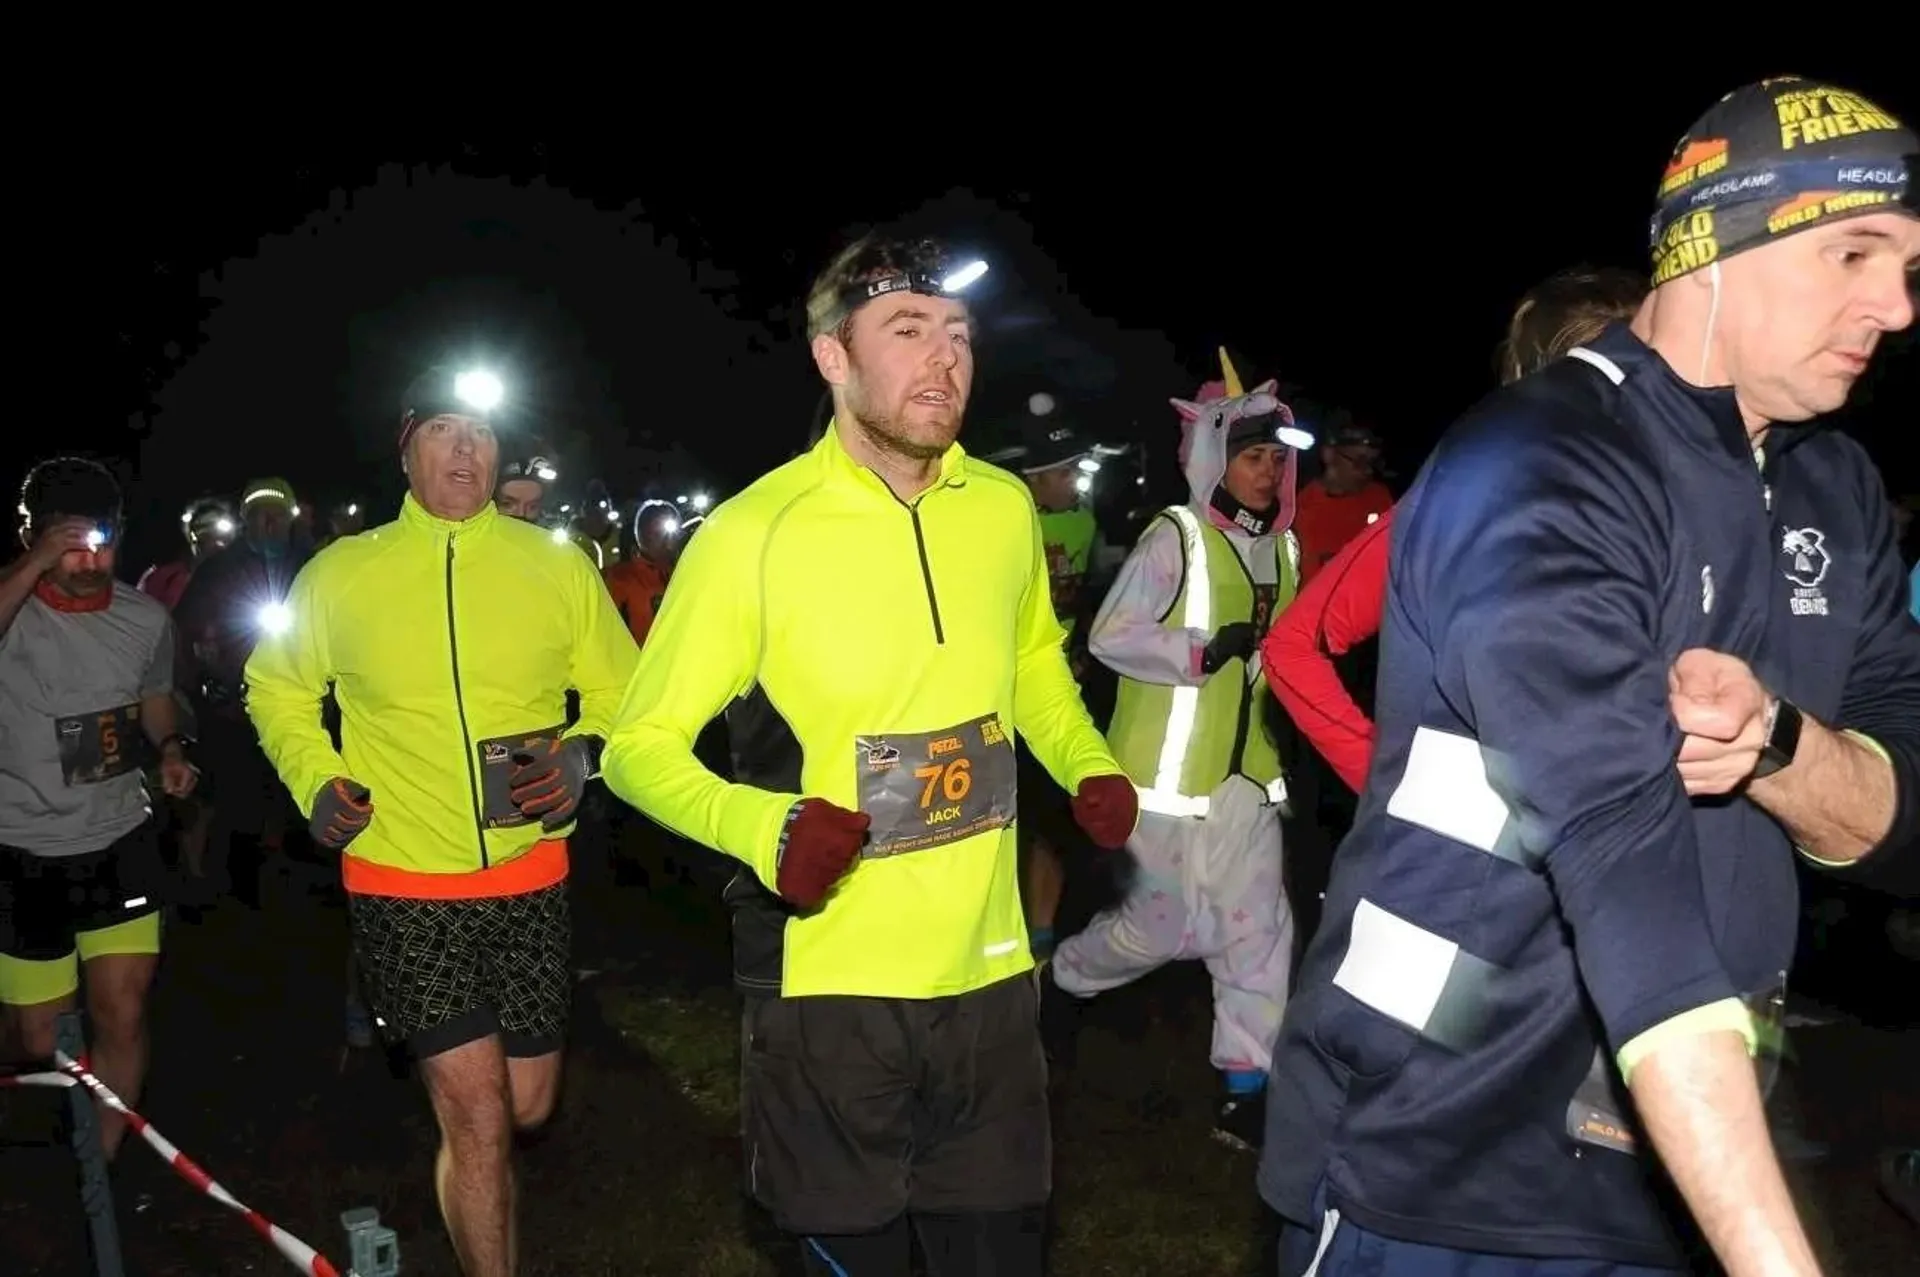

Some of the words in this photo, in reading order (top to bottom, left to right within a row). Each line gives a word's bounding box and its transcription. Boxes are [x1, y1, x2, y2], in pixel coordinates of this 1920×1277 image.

[1777, 100, 1822, 125] MY
[1780, 112, 1899, 149] FRIEND
[1690, 172, 1776, 204] HEADLAMP
[102, 727, 119, 754] 5
[914, 758, 973, 808] 76
[925, 805, 962, 825] JACK
